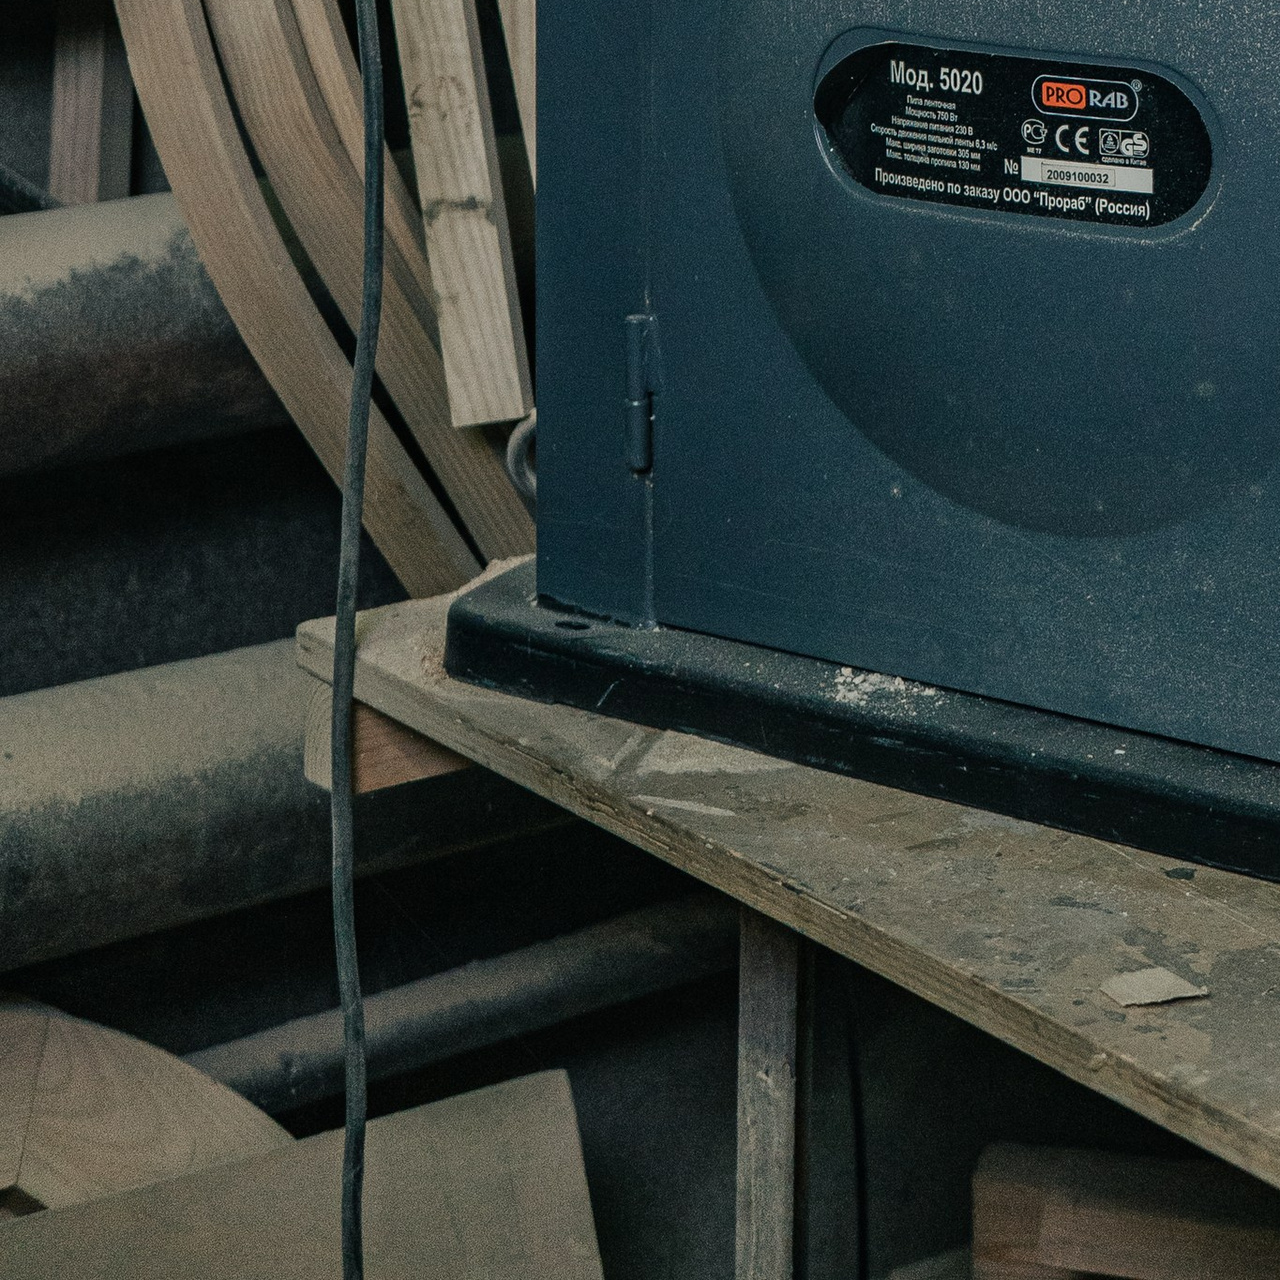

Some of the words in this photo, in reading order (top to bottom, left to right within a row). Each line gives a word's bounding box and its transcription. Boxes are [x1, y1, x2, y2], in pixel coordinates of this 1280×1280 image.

[890, 59, 934, 92] Мод.
[940, 66, 983, 95] 5020
[905, 106, 936, 119] Мощность
[937, 110, 949, 121] 750
[949, 112, 958, 122] Вт
[906, 94, 923, 106] Пила
[924, 99, 957, 111] ленточная
[870, 123, 898, 136] Скорость
[898, 129, 927, 141] движения
[928, 134, 954, 145] пильной
[954, 138, 975, 148] ленты
[975, 139, 986, 150] 6,3
[986, 141, 998, 151] м/с
[891, 115, 928, 128] Напряжение
[929, 122, 955, 133] питания
[955, 124, 967, 136] 230
[885, 137, 902, 149] Макс.
[902, 141, 926, 152] ширина
[927, 145, 957, 157] заготовки
[957, 148, 970, 159] 305
[970, 151, 981, 160] мм
[885, 148, 902, 160] Макс.
[903, 153, 930, 165] толщина
[930, 157, 957, 168] пропила
[958, 160, 970, 170] 130
[970, 162, 981, 171] мм
[1047, 169, 1109, 184] 2009100032
[874, 167, 945, 193] Произведено
[947, 182, 961, 195] по
[963, 184, 1001, 203] заказу
[1003, 187, 1031, 204] ООО
[1095, 197, 1150, 221] (Россия)
